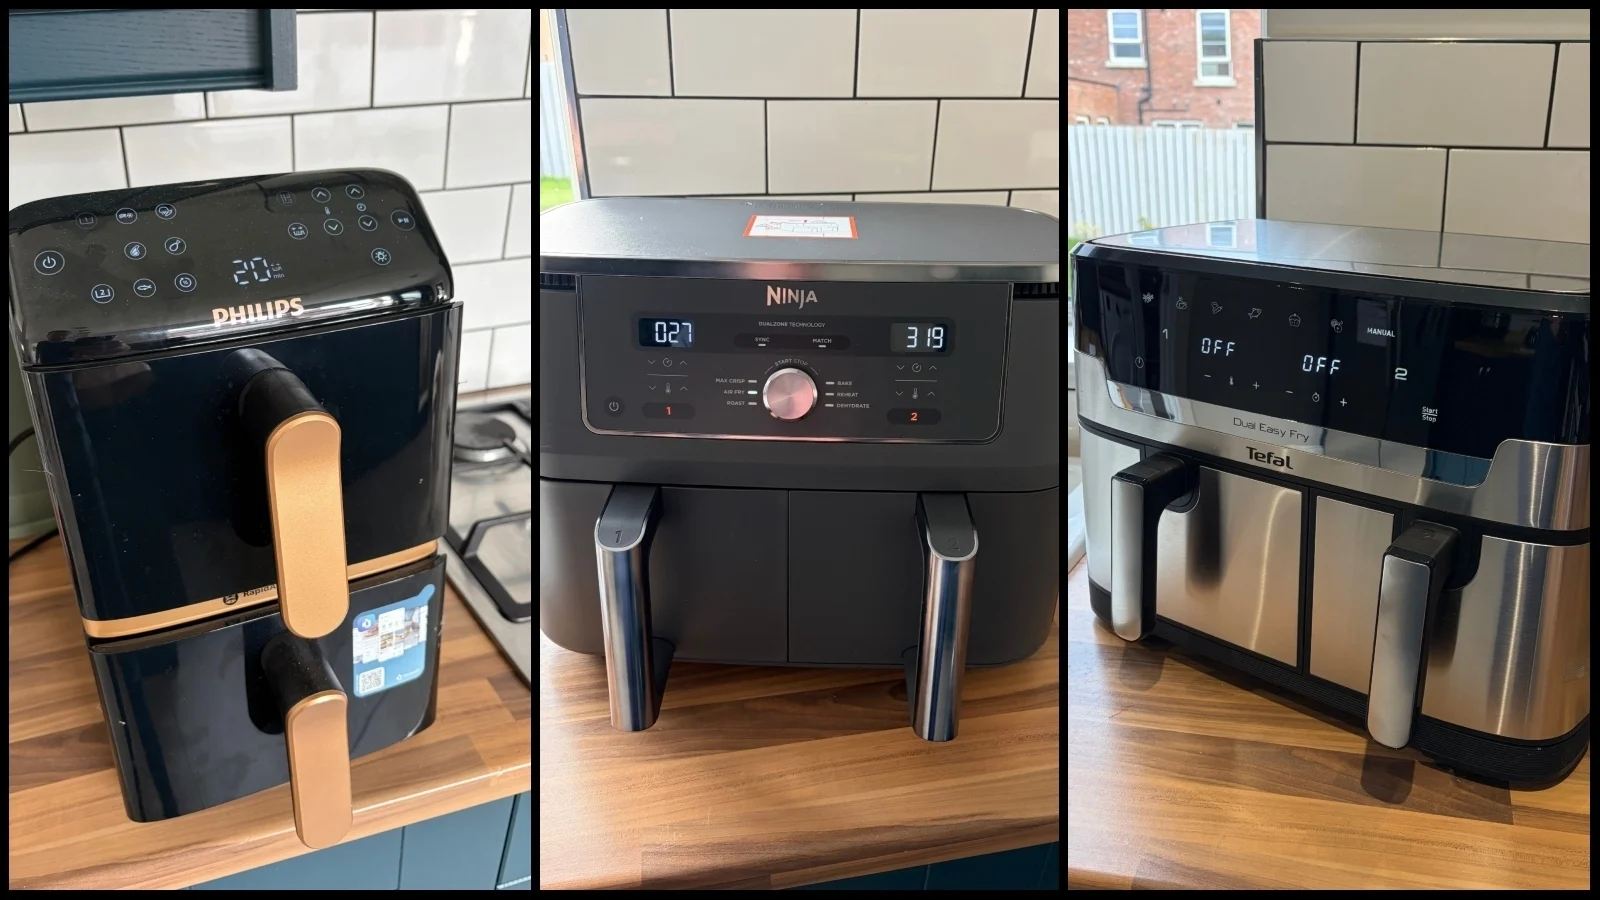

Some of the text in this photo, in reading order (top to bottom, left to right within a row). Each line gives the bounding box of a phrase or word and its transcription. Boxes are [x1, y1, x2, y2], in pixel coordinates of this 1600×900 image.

[232, 257, 272, 285] 20
[766, 285, 818, 309] NINJA
[212, 297, 304, 327] PHILIPS
[655, 321, 692, 343] 027
[906, 327, 944, 348] 319
[1162, 328, 1169, 339] 1
[1366, 327, 1396, 338] MANUAL
[1201, 337, 1236, 357] OFF
[774, 358, 808, 367] START STOP
[1302, 354, 1341, 375] OFF
[1394, 367, 1408, 381] 2
[665, 406, 672, 415] 1
[910, 412, 918, 421] 2
[1421, 406, 1438, 415] Start
[1421, 414, 1437, 423] Stop
[1233, 417, 1310, 443] Dual Easy Fry
[1245, 446, 1294, 470] Tefal
